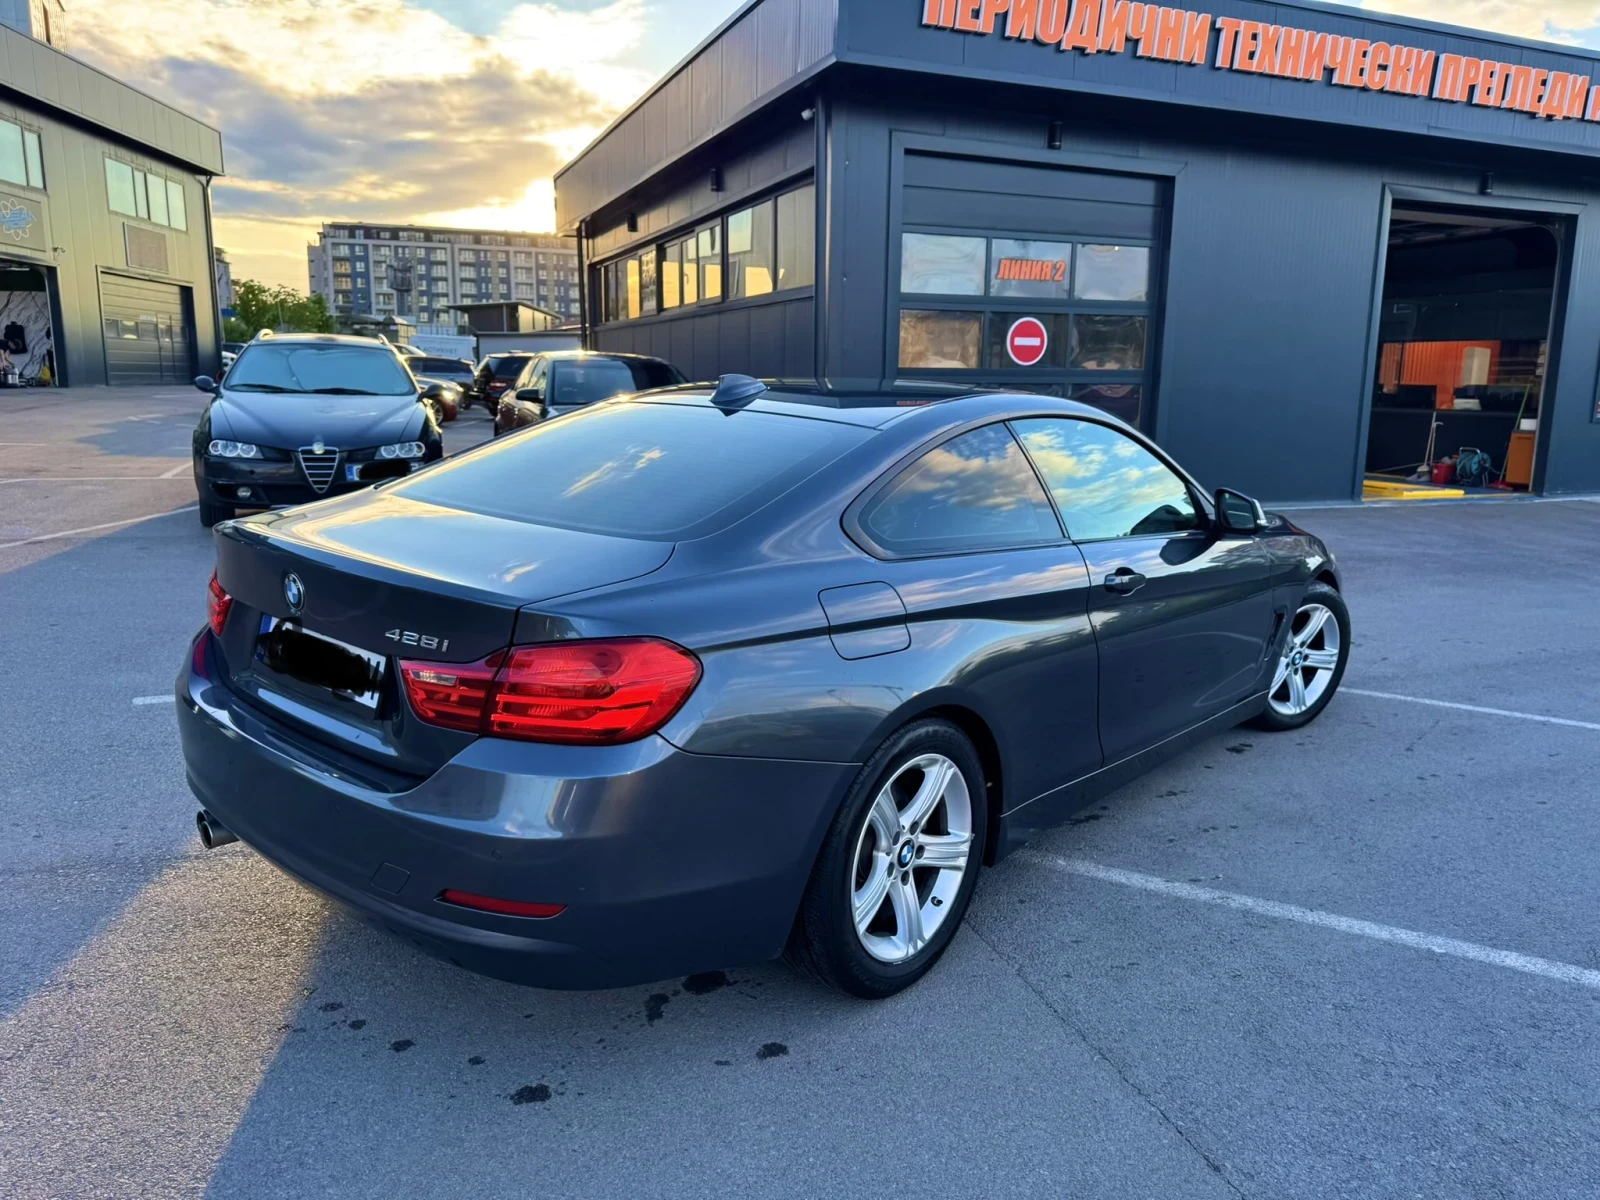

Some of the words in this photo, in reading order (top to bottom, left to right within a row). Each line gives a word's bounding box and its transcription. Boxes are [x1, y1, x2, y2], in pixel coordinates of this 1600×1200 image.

[1215, 16, 1435, 96] ТЕХНИЧЕСКИ
[1432, 53, 1590, 120] ПРЕГЛЕДИ
[996, 258, 1053, 281] ЛИНИЯ
[1052, 260, 1066, 281] 2
[384, 628, 449, 652] 428i
